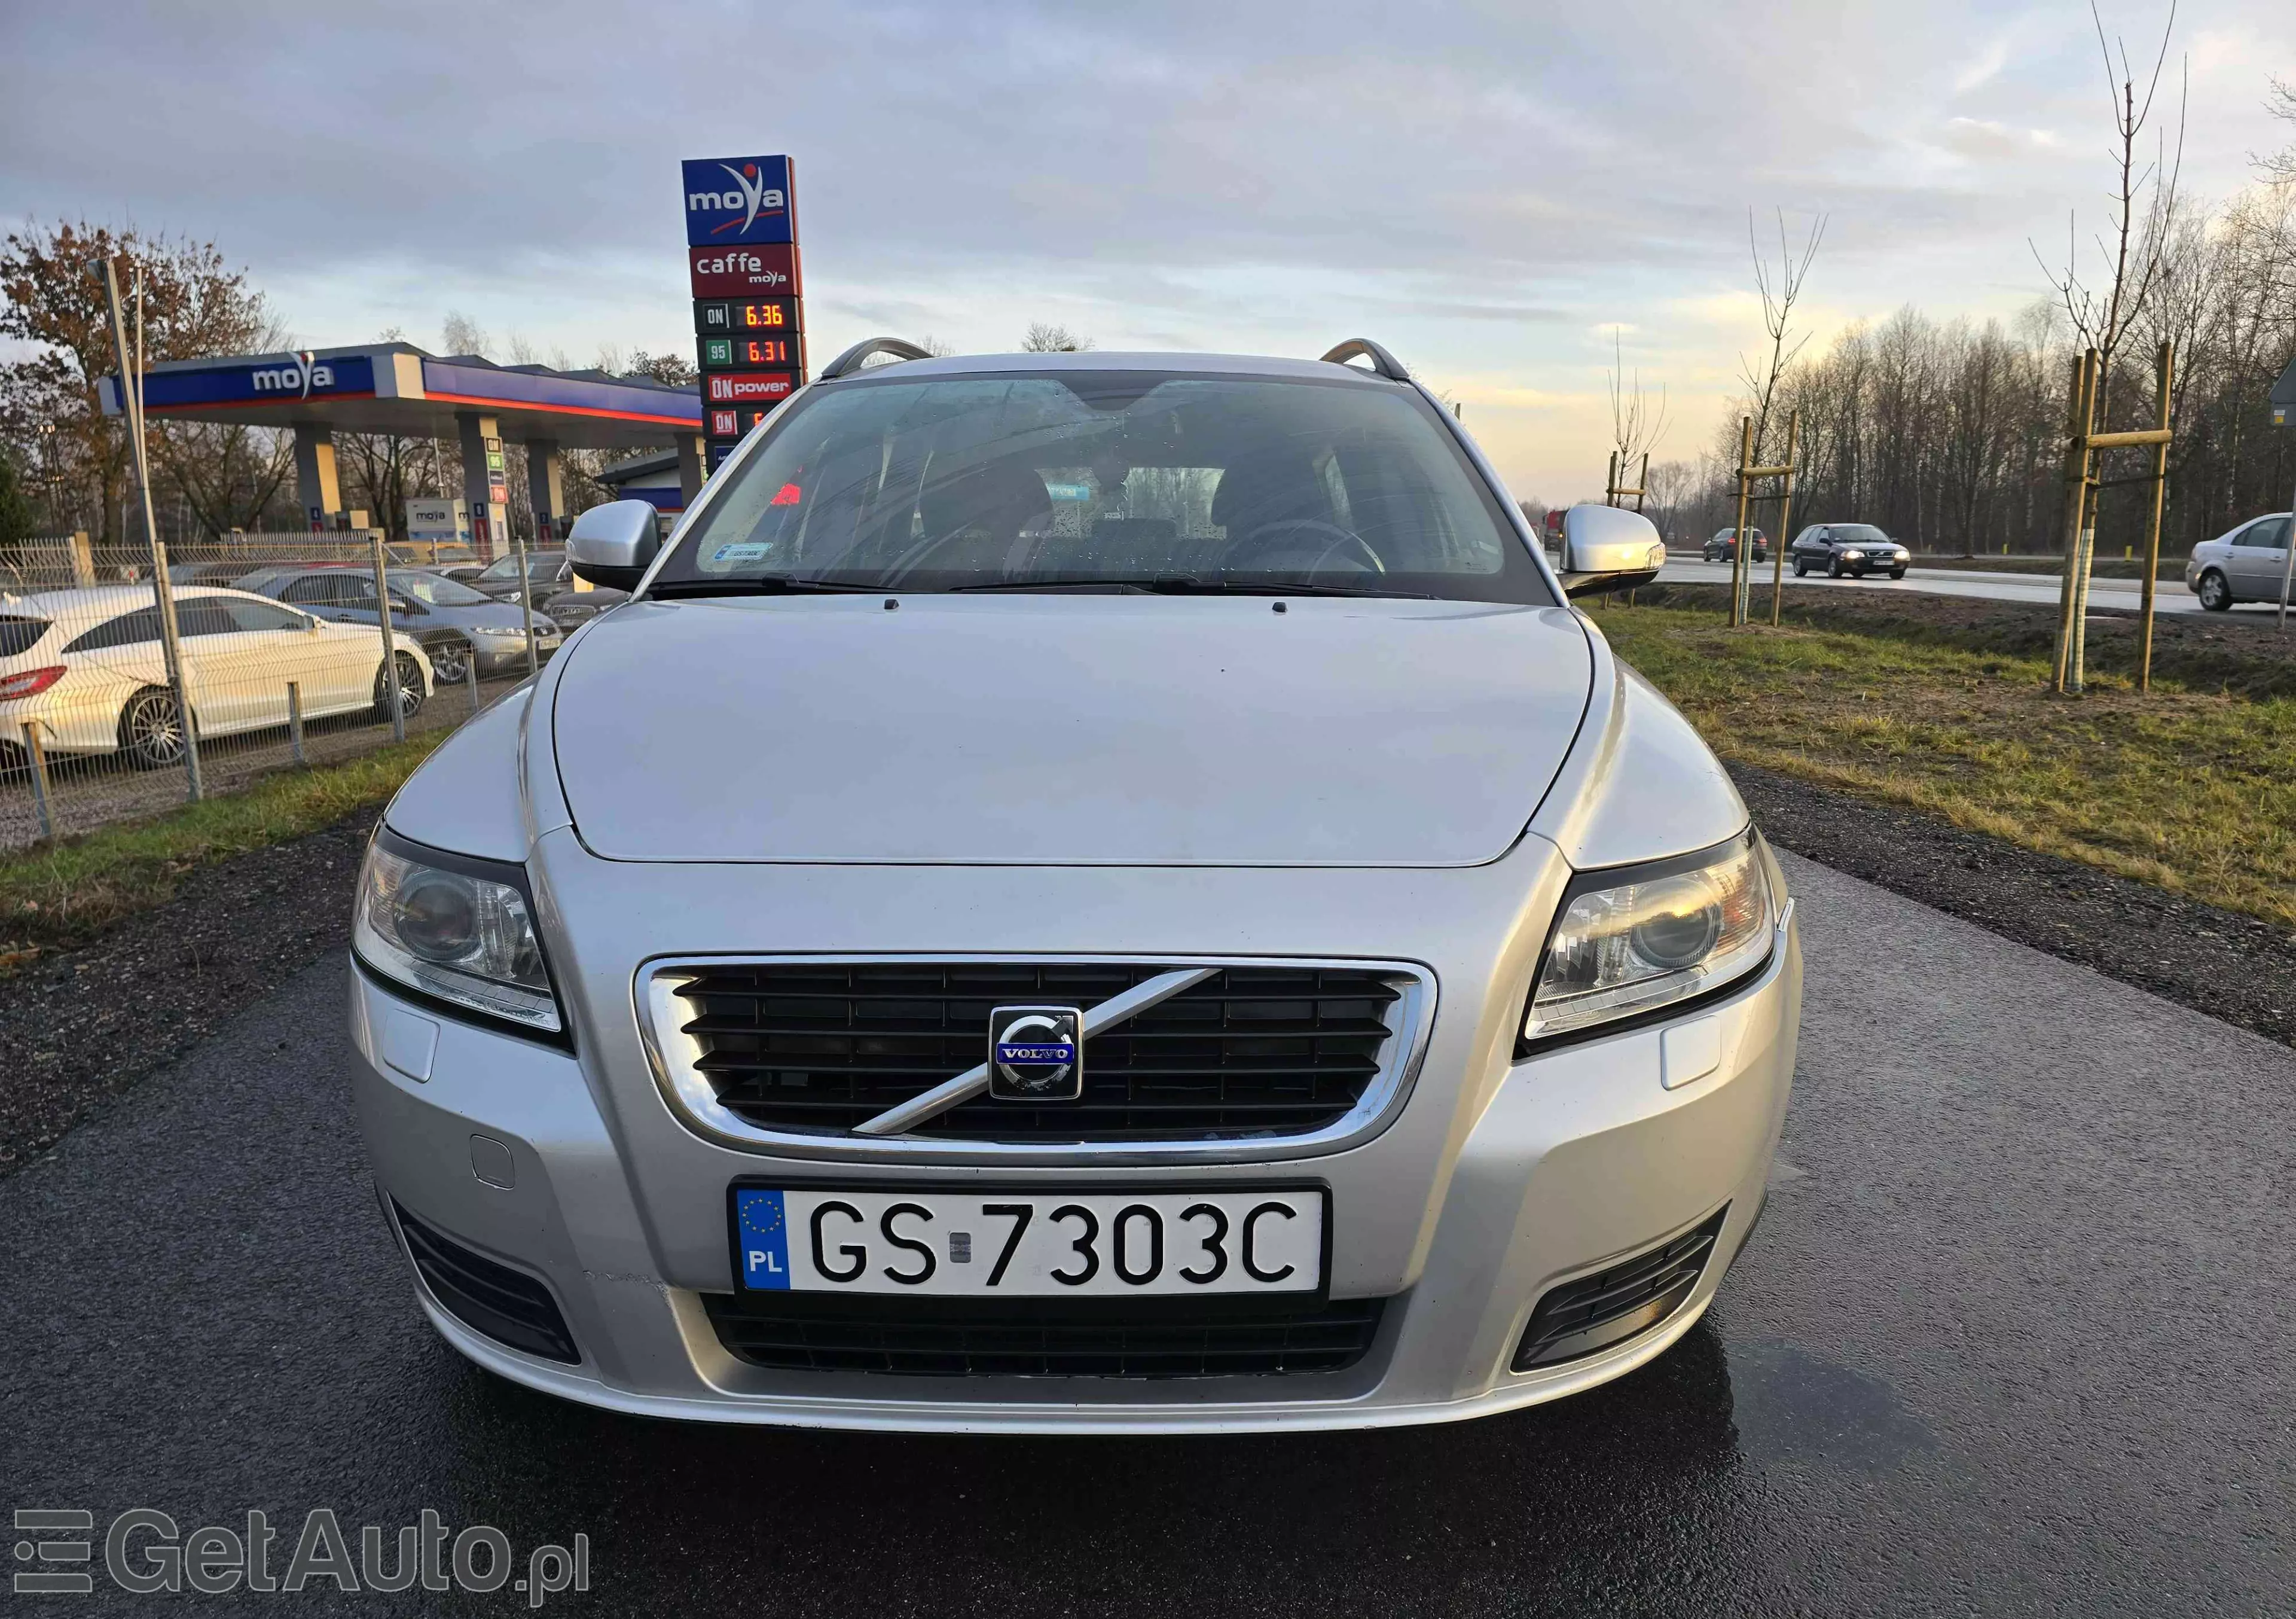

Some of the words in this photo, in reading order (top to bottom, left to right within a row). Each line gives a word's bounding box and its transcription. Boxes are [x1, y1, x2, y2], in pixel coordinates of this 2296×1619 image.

[689, 163, 783, 235] moya
[697, 252, 762, 274] caffe
[749, 270, 787, 288] moya
[707, 308, 724, 325] ON
[745, 304, 783, 326] 6.36
[710, 345, 726, 359] 95
[748, 340, 787, 362] 6.31
[252, 350, 335, 400] moya
[715, 413, 733, 429] ON
[1002, 1048, 1068, 1059] VOLVO
[810, 1200, 937, 1286] GS
[981, 1201, 1297, 1287] 7303C
[749, 1251, 783, 1273] PL
